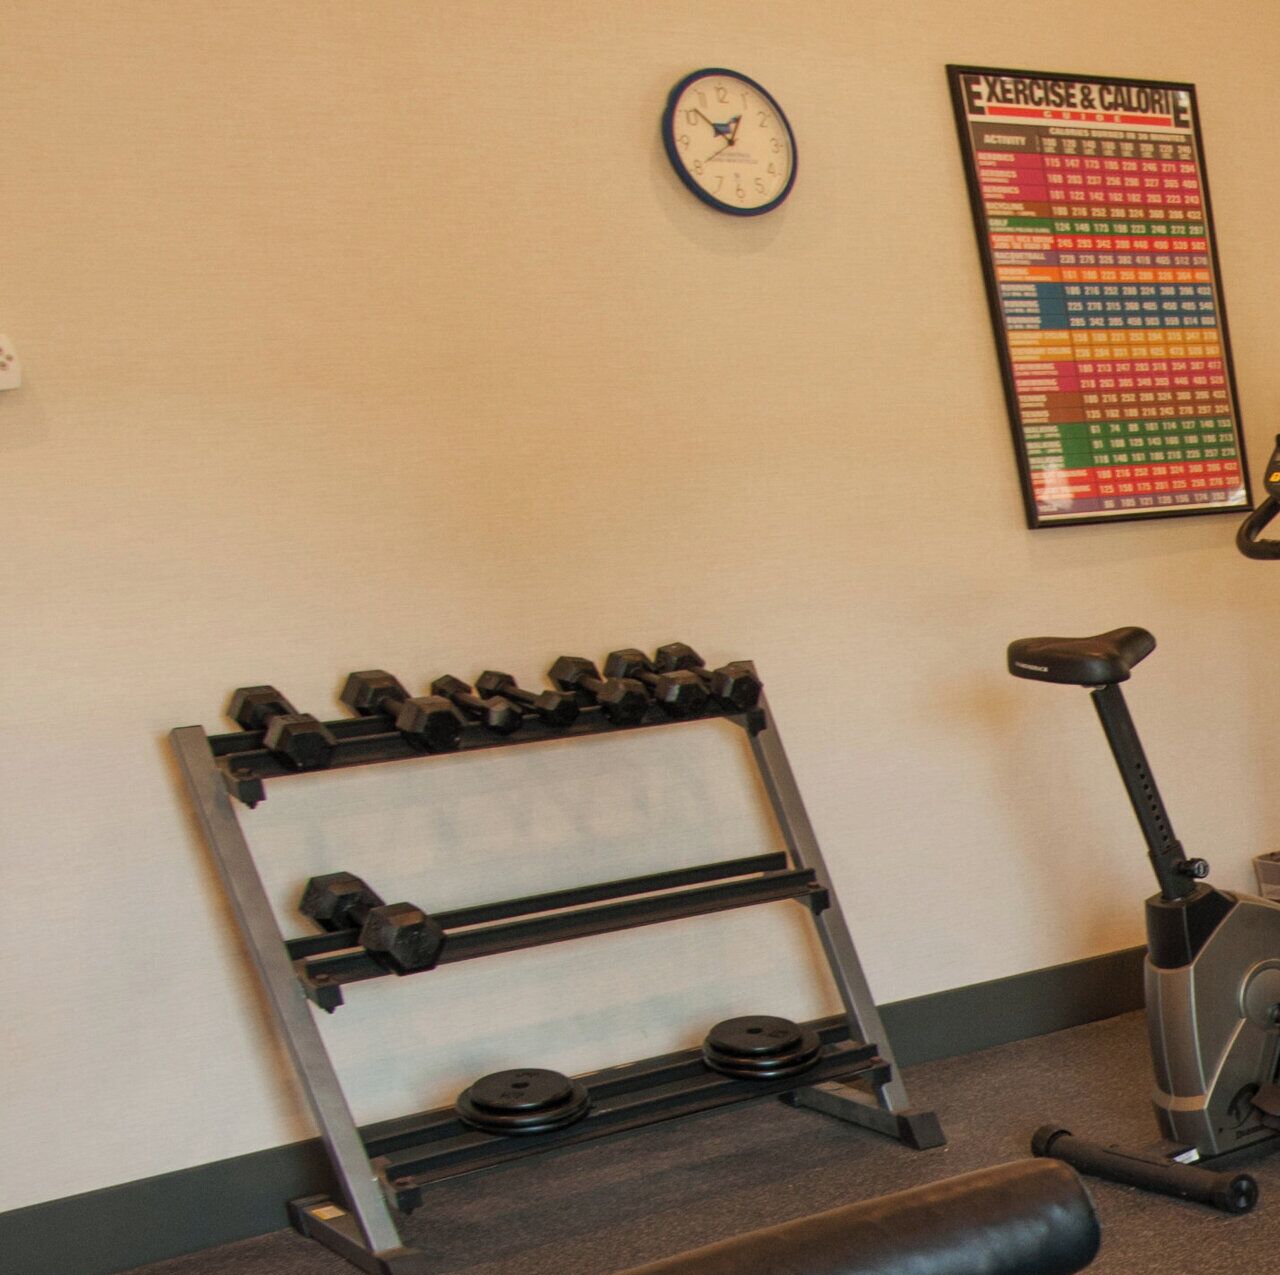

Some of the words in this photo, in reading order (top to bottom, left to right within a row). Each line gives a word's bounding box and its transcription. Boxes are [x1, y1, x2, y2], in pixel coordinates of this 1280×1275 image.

[963, 74, 1077, 115] EXERCISE
[1080, 85, 1096, 110] &
[1100, 84, 1190, 128] CALORIE
[1043, 110, 1121, 123] GUIDE
